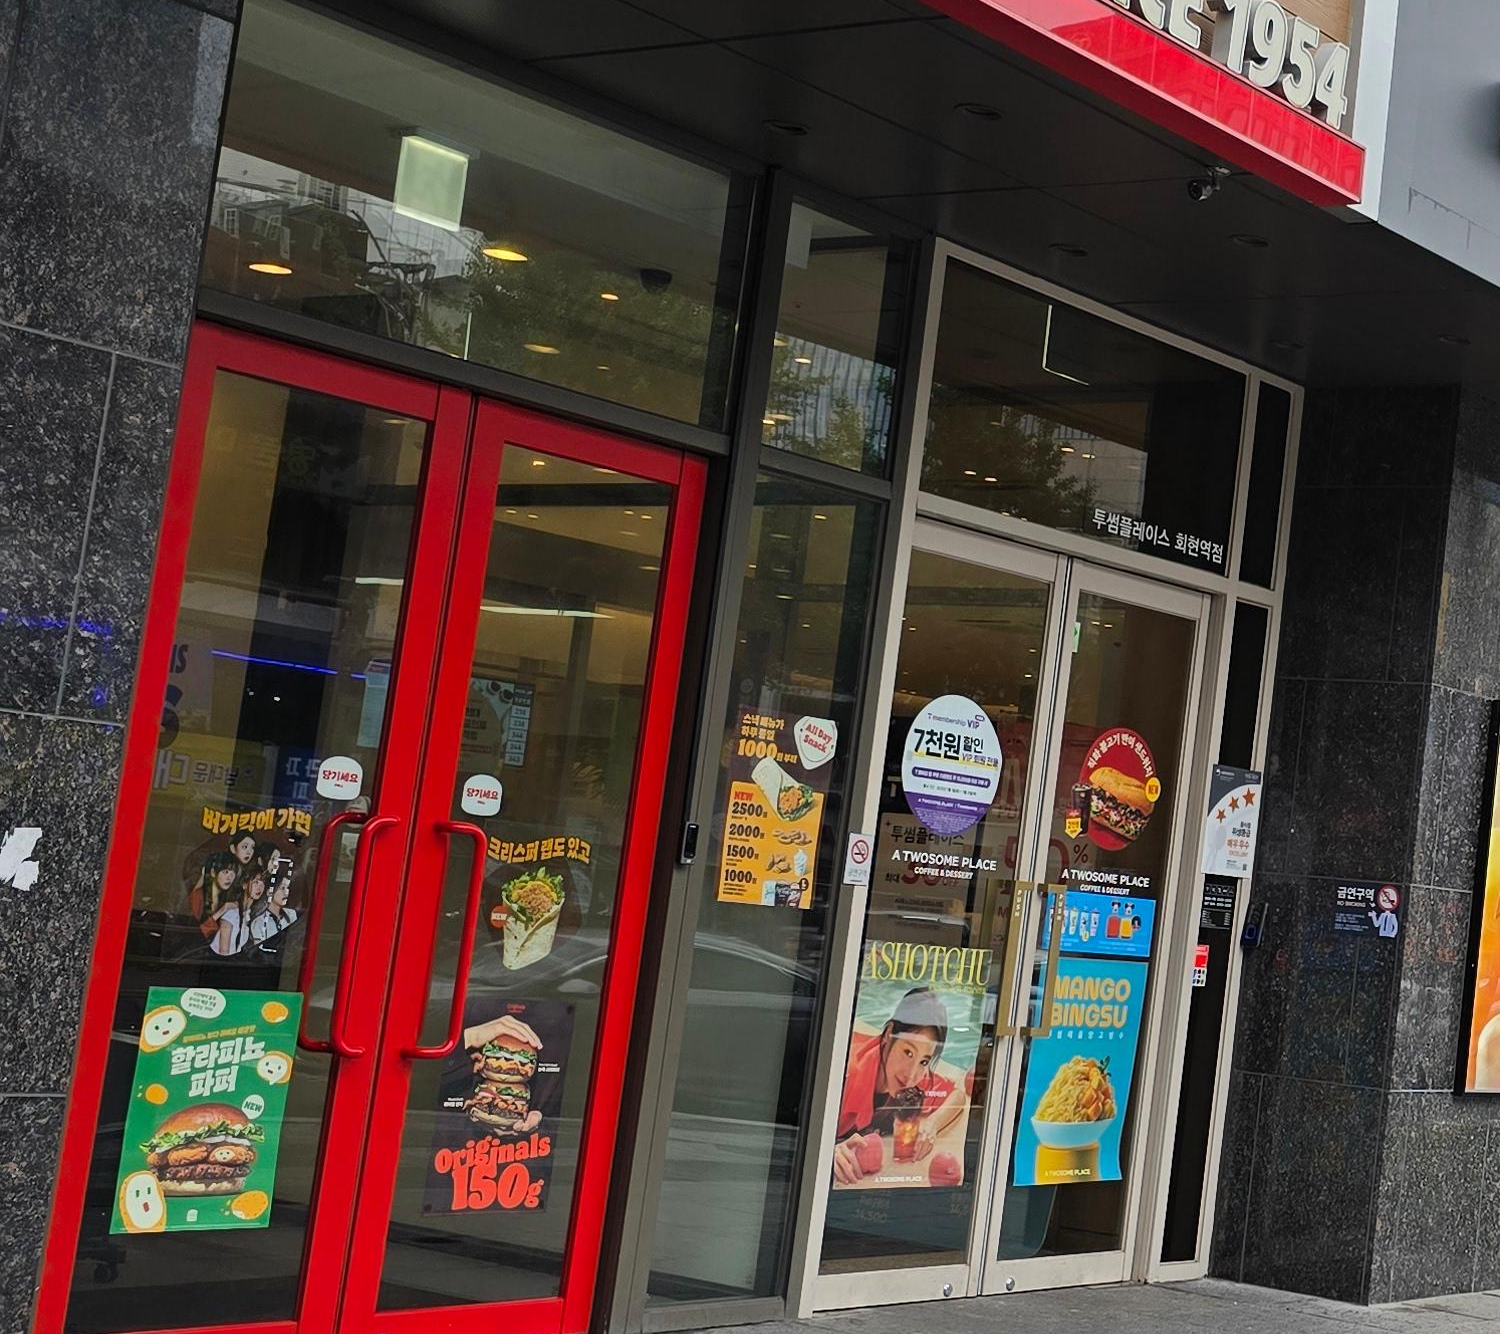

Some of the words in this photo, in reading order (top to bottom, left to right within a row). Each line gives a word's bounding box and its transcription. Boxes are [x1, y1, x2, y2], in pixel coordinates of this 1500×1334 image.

[1092, 509, 1170, 547] 투썸플레이스
[1174, 532, 1224, 564] 회현역점
[805, 723, 818, 736] All
[817, 727, 833, 744] Day
[967, 719, 980, 729] VIP
[803, 734, 828, 754] Snack
[913, 728, 962, 761] 7천원
[963, 736, 985, 754] 할인
[322, 769, 359, 784] 당기세요
[466, 786, 499, 801] 당기세요
[734, 791, 755, 802] NEW
[202, 807, 276, 835] 버거킹에
[276, 807, 312, 837] 가면
[891, 849, 901, 861] A
[902, 850, 959, 868] TWOSOME
[961, 855, 998, 872] PLACE
[914, 866, 940, 878] COFFEE
[945, 869, 974, 880] DESSERT
[1061, 868, 1071, 880] A
[1070, 869, 1118, 885] TWOSOME
[1118, 874, 1151, 888] PLACE
[1336, 886, 1375, 902] 금연구역
[866, 941, 993, 987] ASHOTCHU
[1053, 974, 1131, 1003] MANGO
[1051, 1002, 1129, 1029] BINGSU
[170, 1036, 267, 1076] 할라피뇨
[188, 1065, 240, 1098] 파퍼
[243, 1099, 264, 1114] NEW
[434, 1133, 551, 1174] Originals
[451, 1162, 545, 1211] 150g
